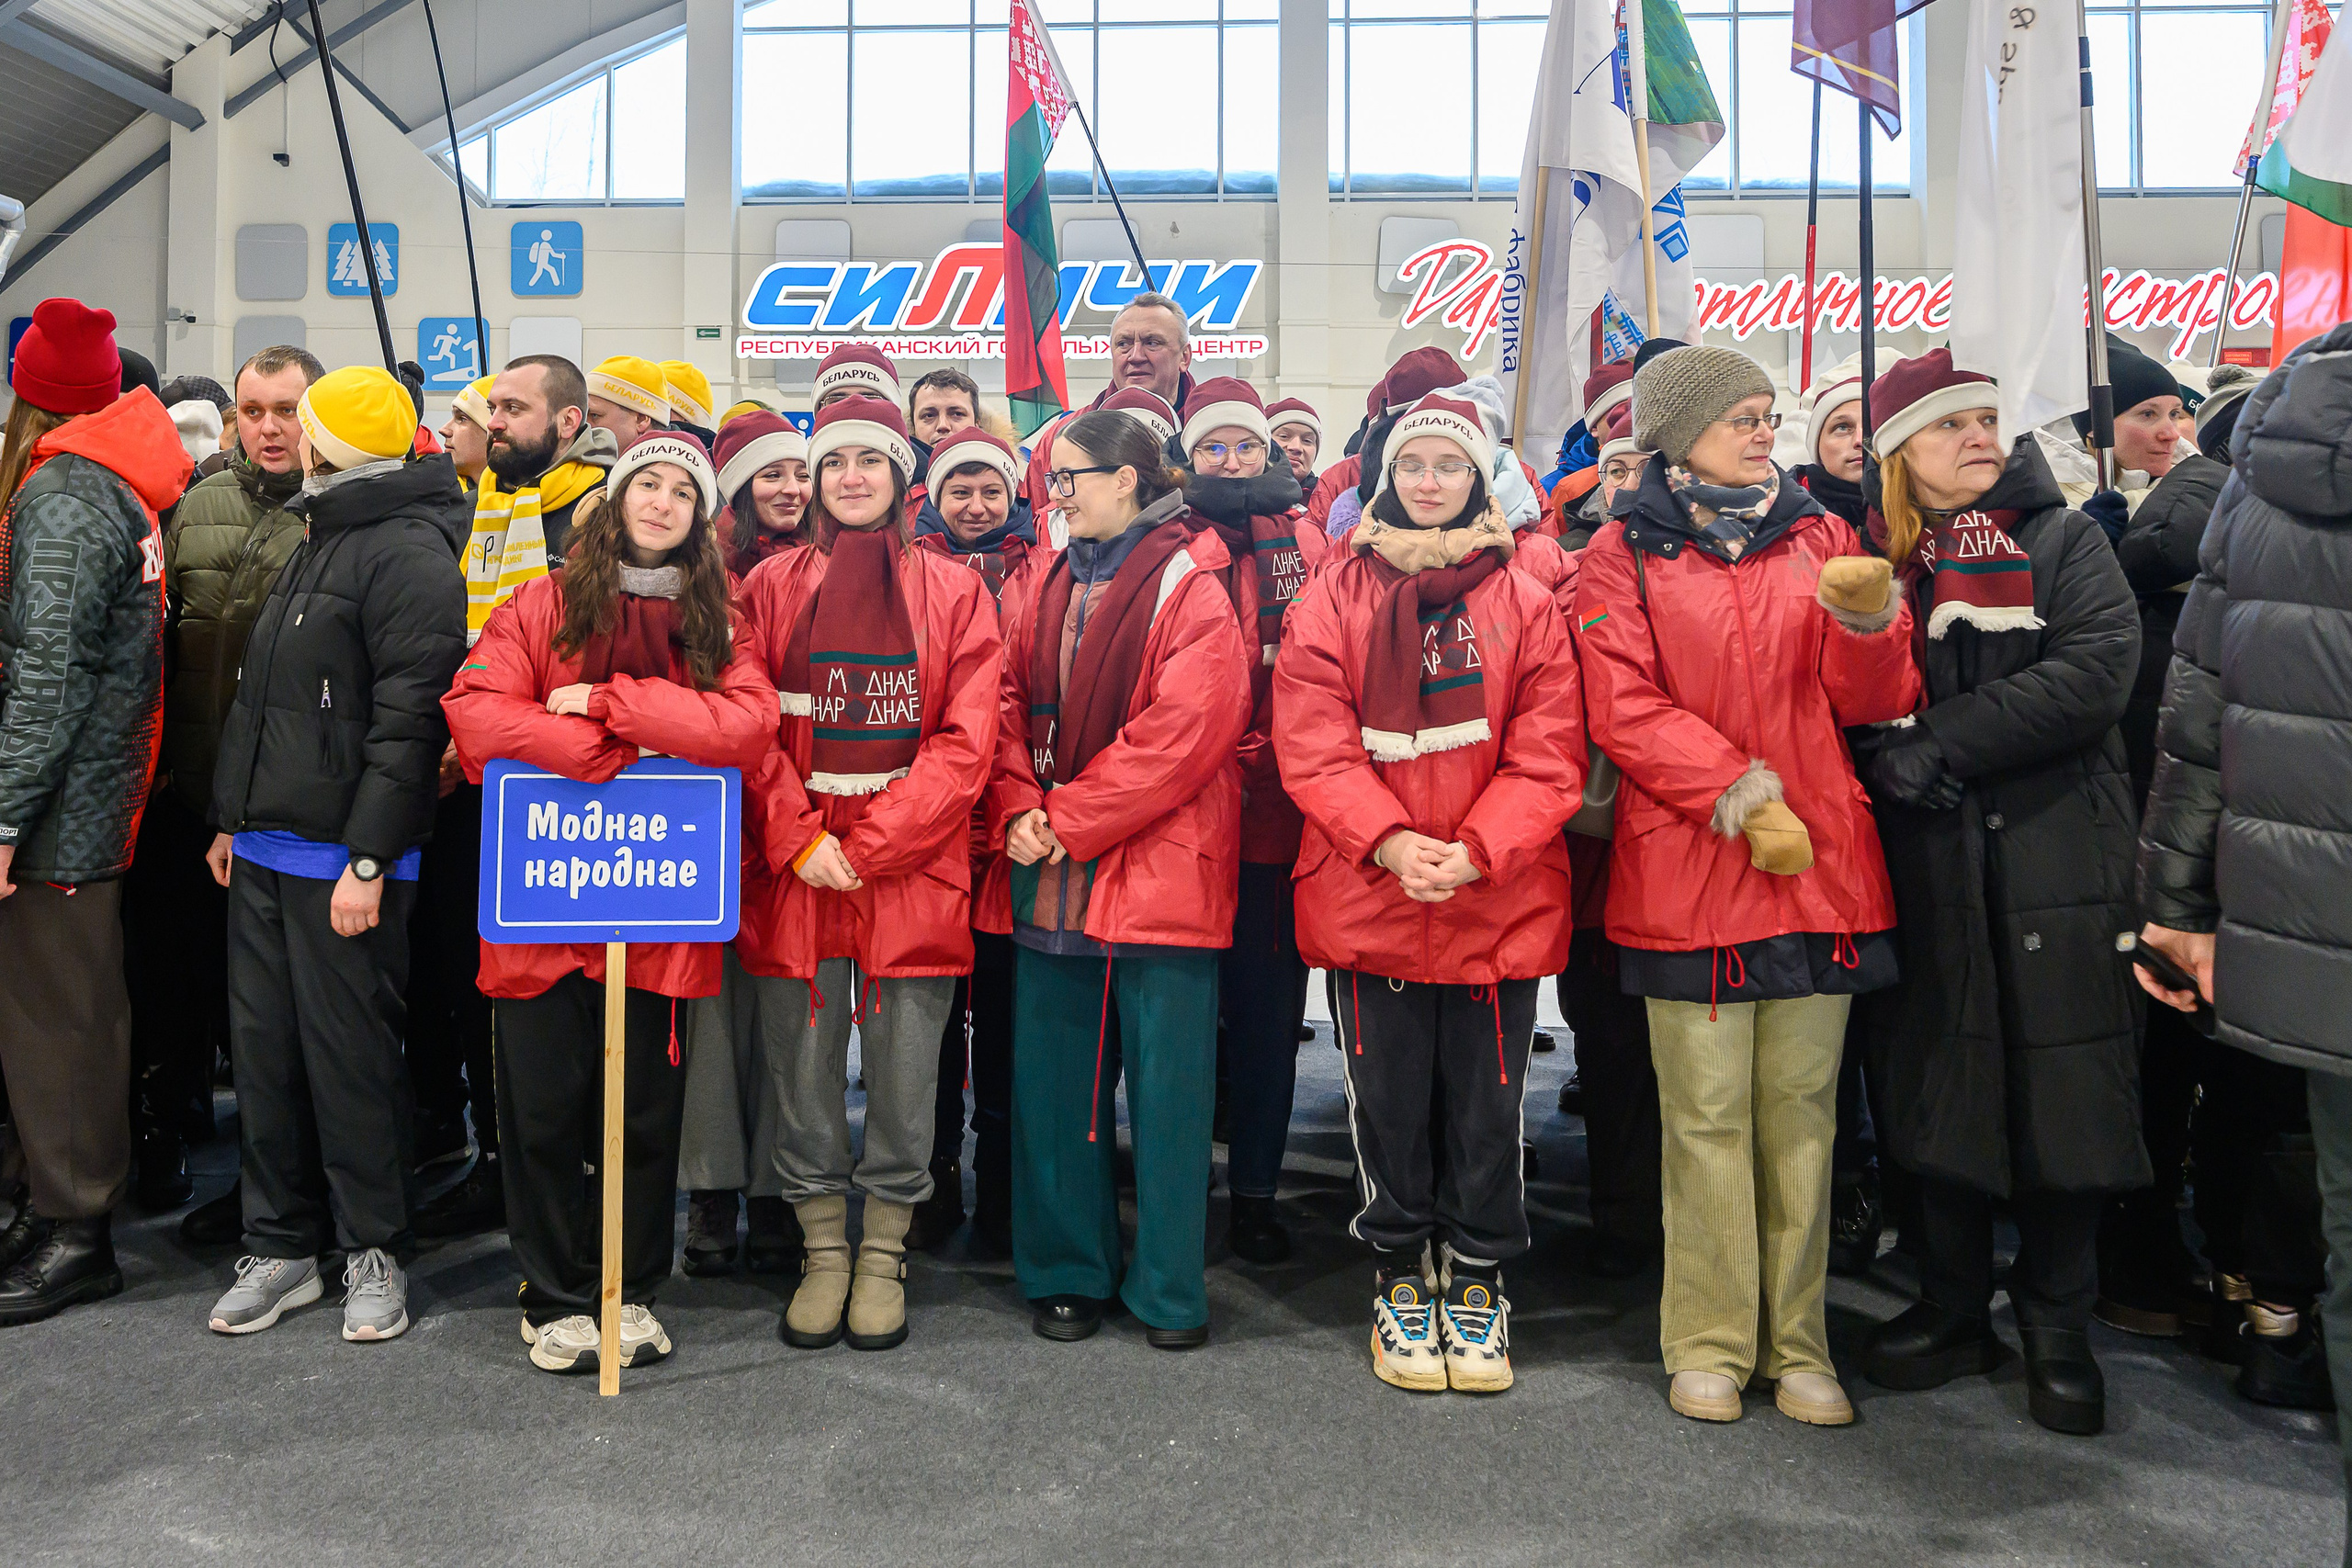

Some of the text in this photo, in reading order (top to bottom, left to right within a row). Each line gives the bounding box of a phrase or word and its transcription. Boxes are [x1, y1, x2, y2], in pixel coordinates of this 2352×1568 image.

[741, 337, 980, 355] РЕСПУБЛАНСКИЙ
[822, 369, 880, 388] БЕЛАРУСЬ
[604, 381, 657, 411] БЕЛАРУСЬ
[668, 390, 696, 417] АРУСЬ
[1404, 417, 1474, 441] БЕЛАРУСЬ
[631, 445, 700, 468] БЕЛАРУСЬ
[526, 800, 668, 842] Моднае
[525, 846, 698, 900] народнае
